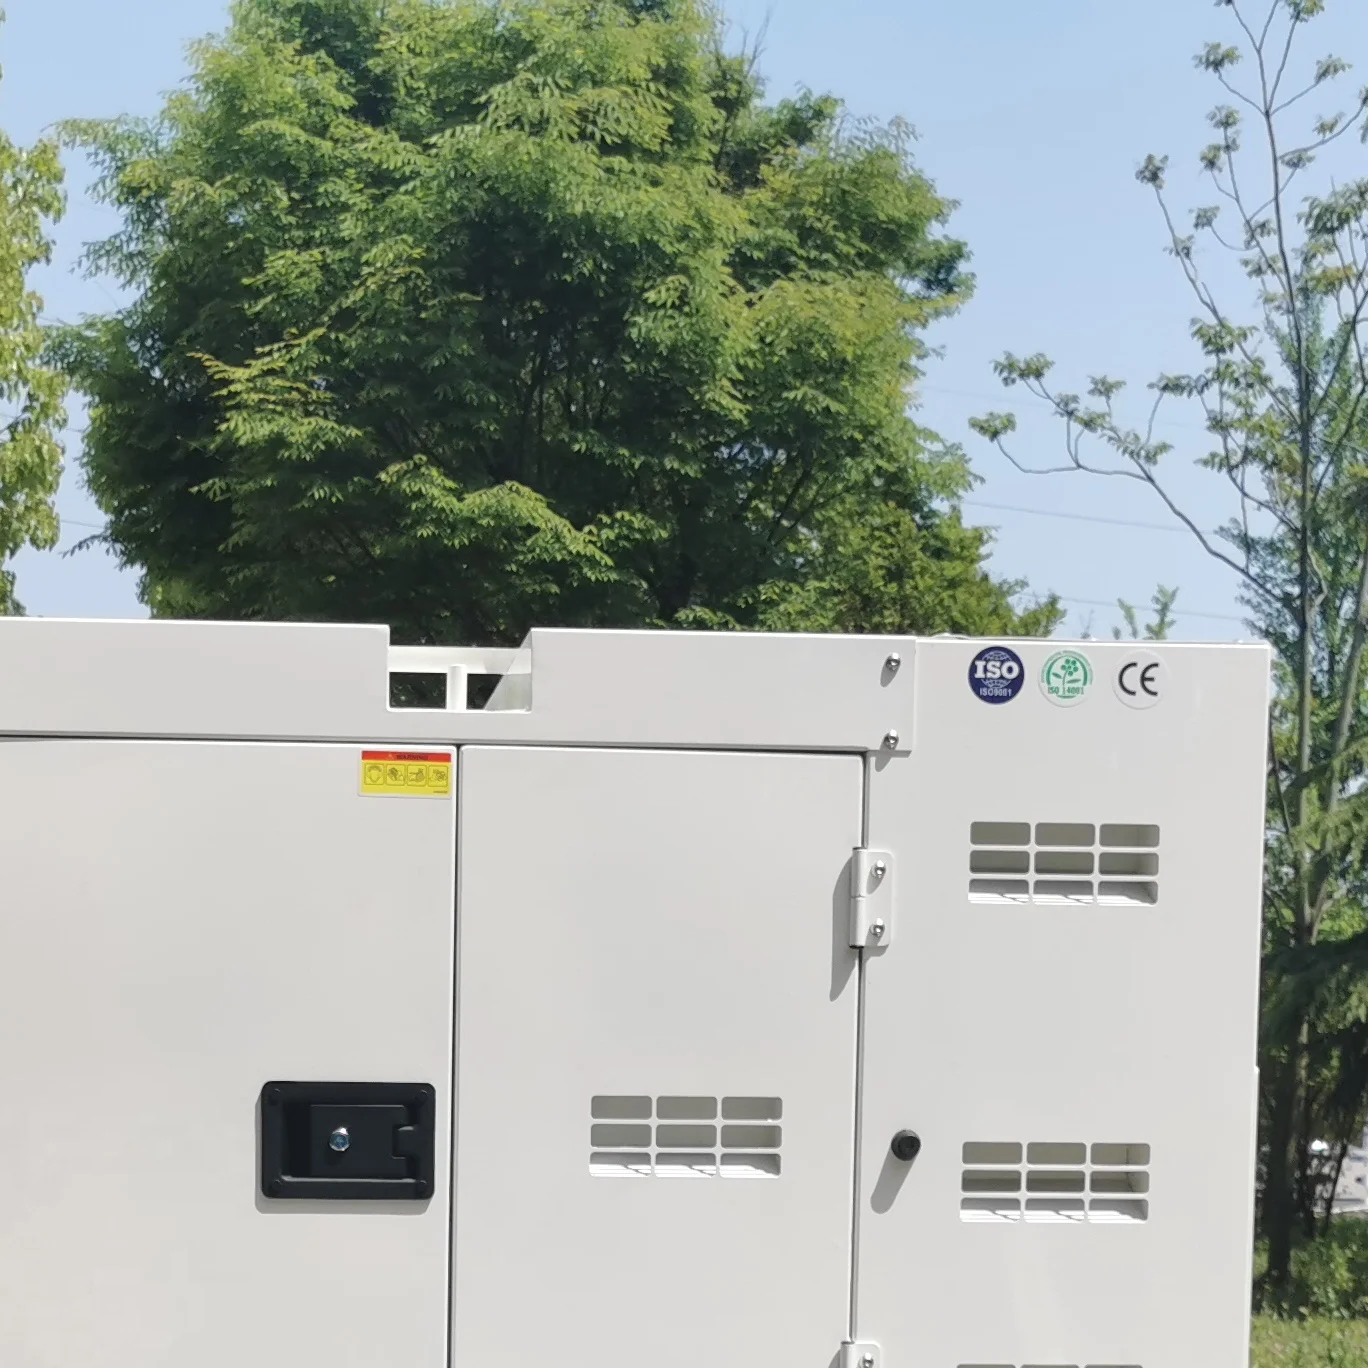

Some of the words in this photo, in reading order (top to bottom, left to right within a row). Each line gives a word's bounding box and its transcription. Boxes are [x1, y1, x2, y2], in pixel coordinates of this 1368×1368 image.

[974, 660, 1020, 680] ISO
[1118, 662, 1160, 696] CE
[979, 687, 1012, 697] ISO9001
[1047, 686, 1059, 695] ISO
